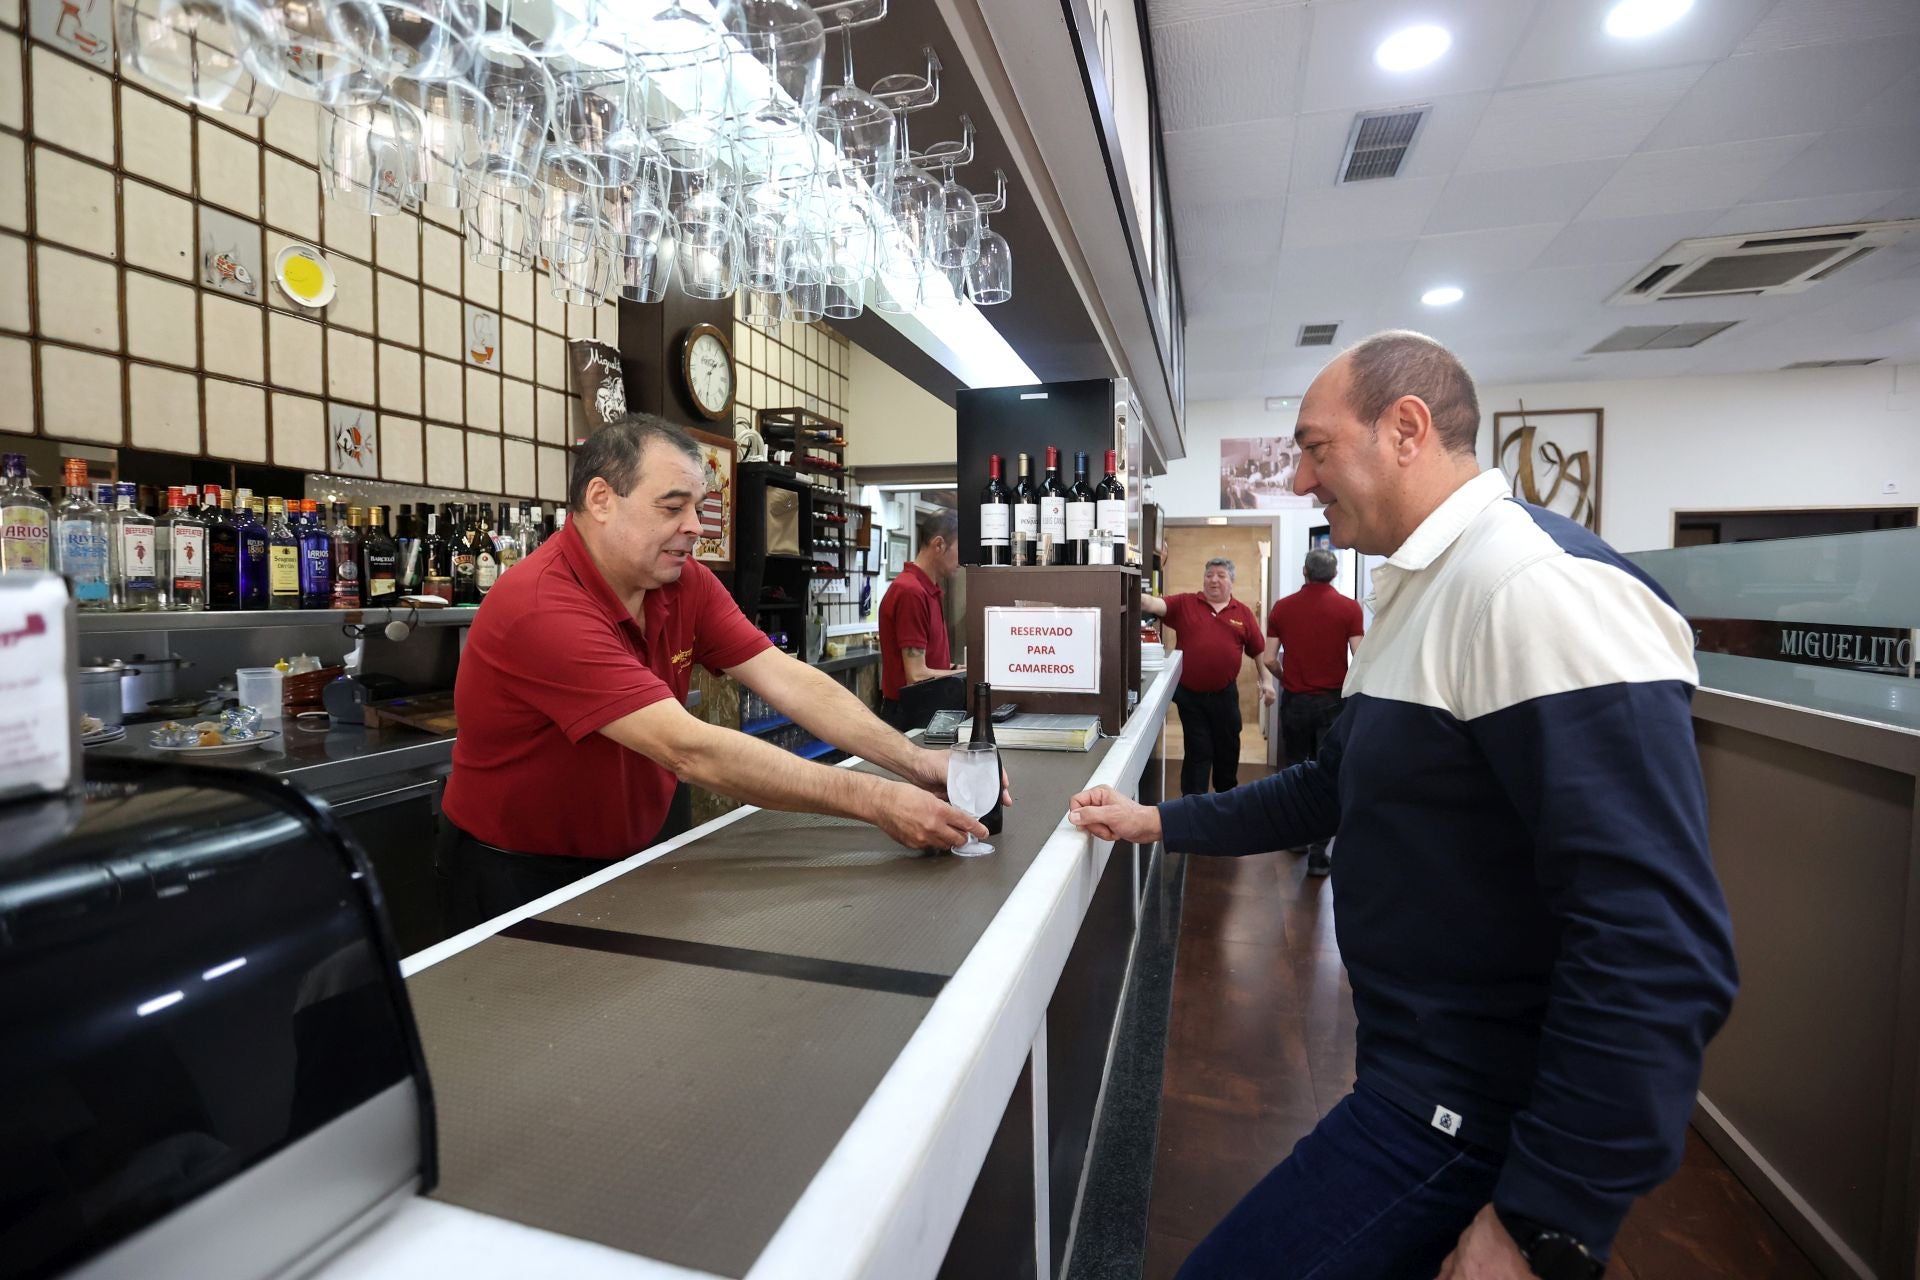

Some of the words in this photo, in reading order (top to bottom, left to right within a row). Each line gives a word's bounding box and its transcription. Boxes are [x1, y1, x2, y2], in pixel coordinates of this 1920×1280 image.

[3, 525, 49, 540] ARIOS
[125, 527, 154, 535] BEEFEATER
[176, 527, 202, 536] BEEFEATER
[69, 534, 107, 545] RIVES
[308, 549, 329, 559] LARIOS
[315, 560, 326, 571] 12
[1010, 626, 1073, 637] RESERVADO
[1027, 645, 1056, 655] PARA
[1780, 629, 1914, 668] MIGUELITO
[1008, 663, 1075, 674] CAMAREROS
